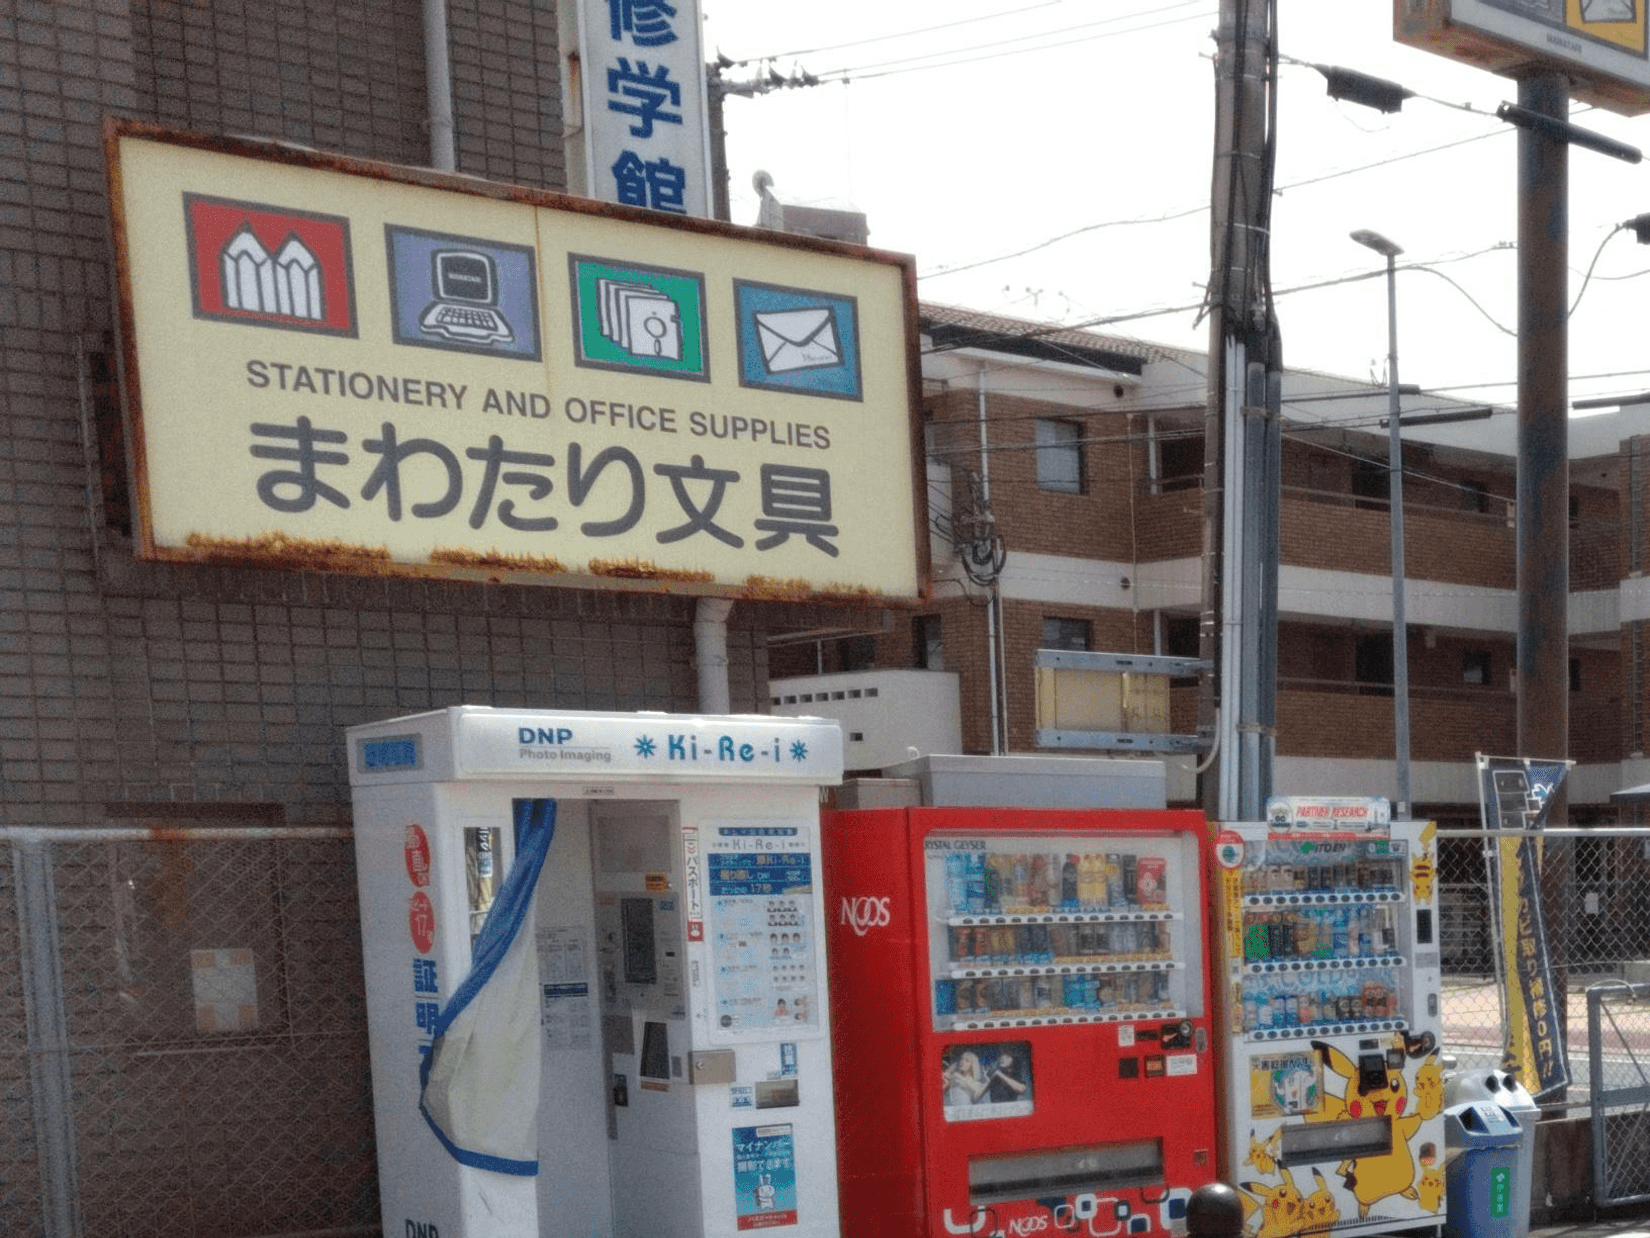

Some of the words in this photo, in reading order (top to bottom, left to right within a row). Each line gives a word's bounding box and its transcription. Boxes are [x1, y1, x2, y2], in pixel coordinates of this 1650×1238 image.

[606, 0, 688, 214] 修学館
[246, 360, 469, 409] STATIONERY
[481, 388, 552, 419] AND
[564, 396, 679, 434] OFFICE
[689, 411, 831, 450] SUPPLIES
[249, 415, 840, 558] まわたり文具
[518, 727, 573, 745] DNP
[519, 748, 558, 761] Photo
[560, 750, 612, 763] Imaging
[668, 735, 780, 763] Ki-Re-i
[686, 856, 699, 910] パスポート
[413, 958, 440, 1062] 証明
